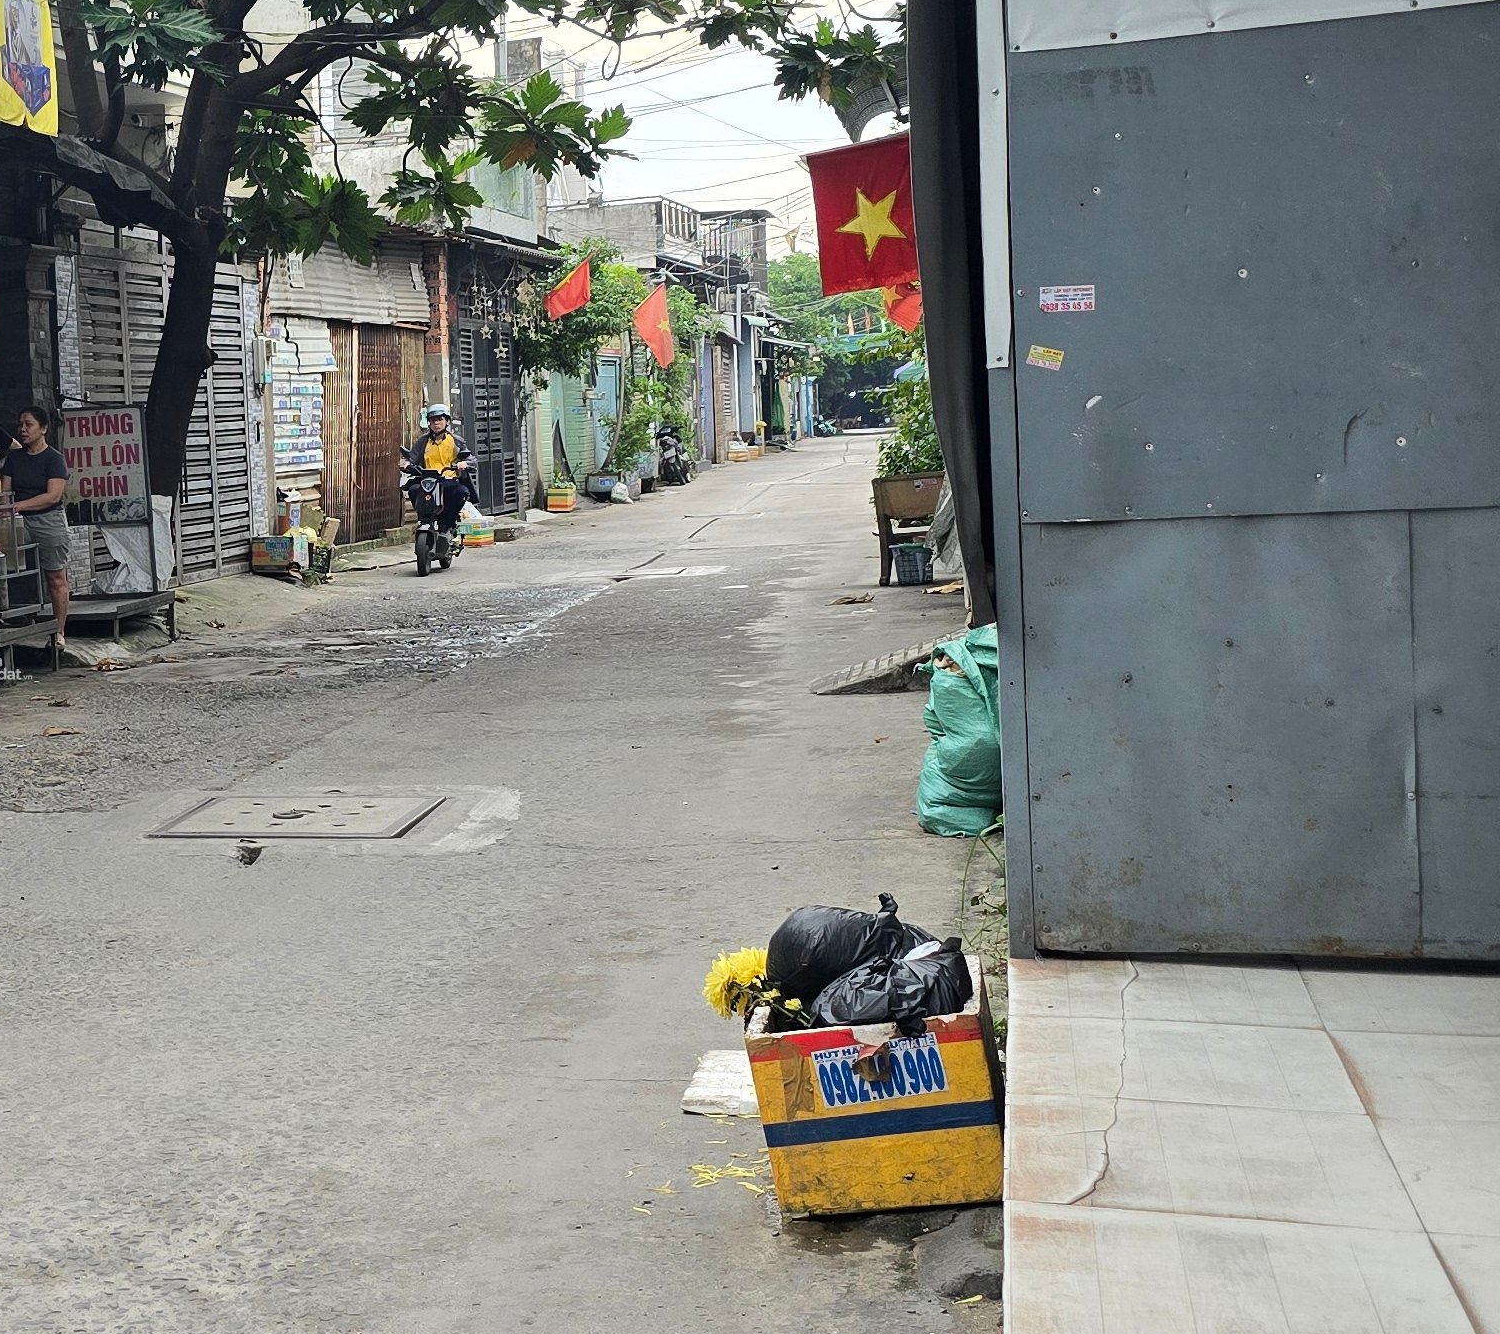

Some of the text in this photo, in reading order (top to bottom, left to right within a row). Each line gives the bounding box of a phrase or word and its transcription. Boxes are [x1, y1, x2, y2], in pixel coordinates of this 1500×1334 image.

[66, 411, 133, 438] TRỨNG
[64, 440, 140, 472] VỊT LỘN
[80, 471, 129, 498] CHÍN
